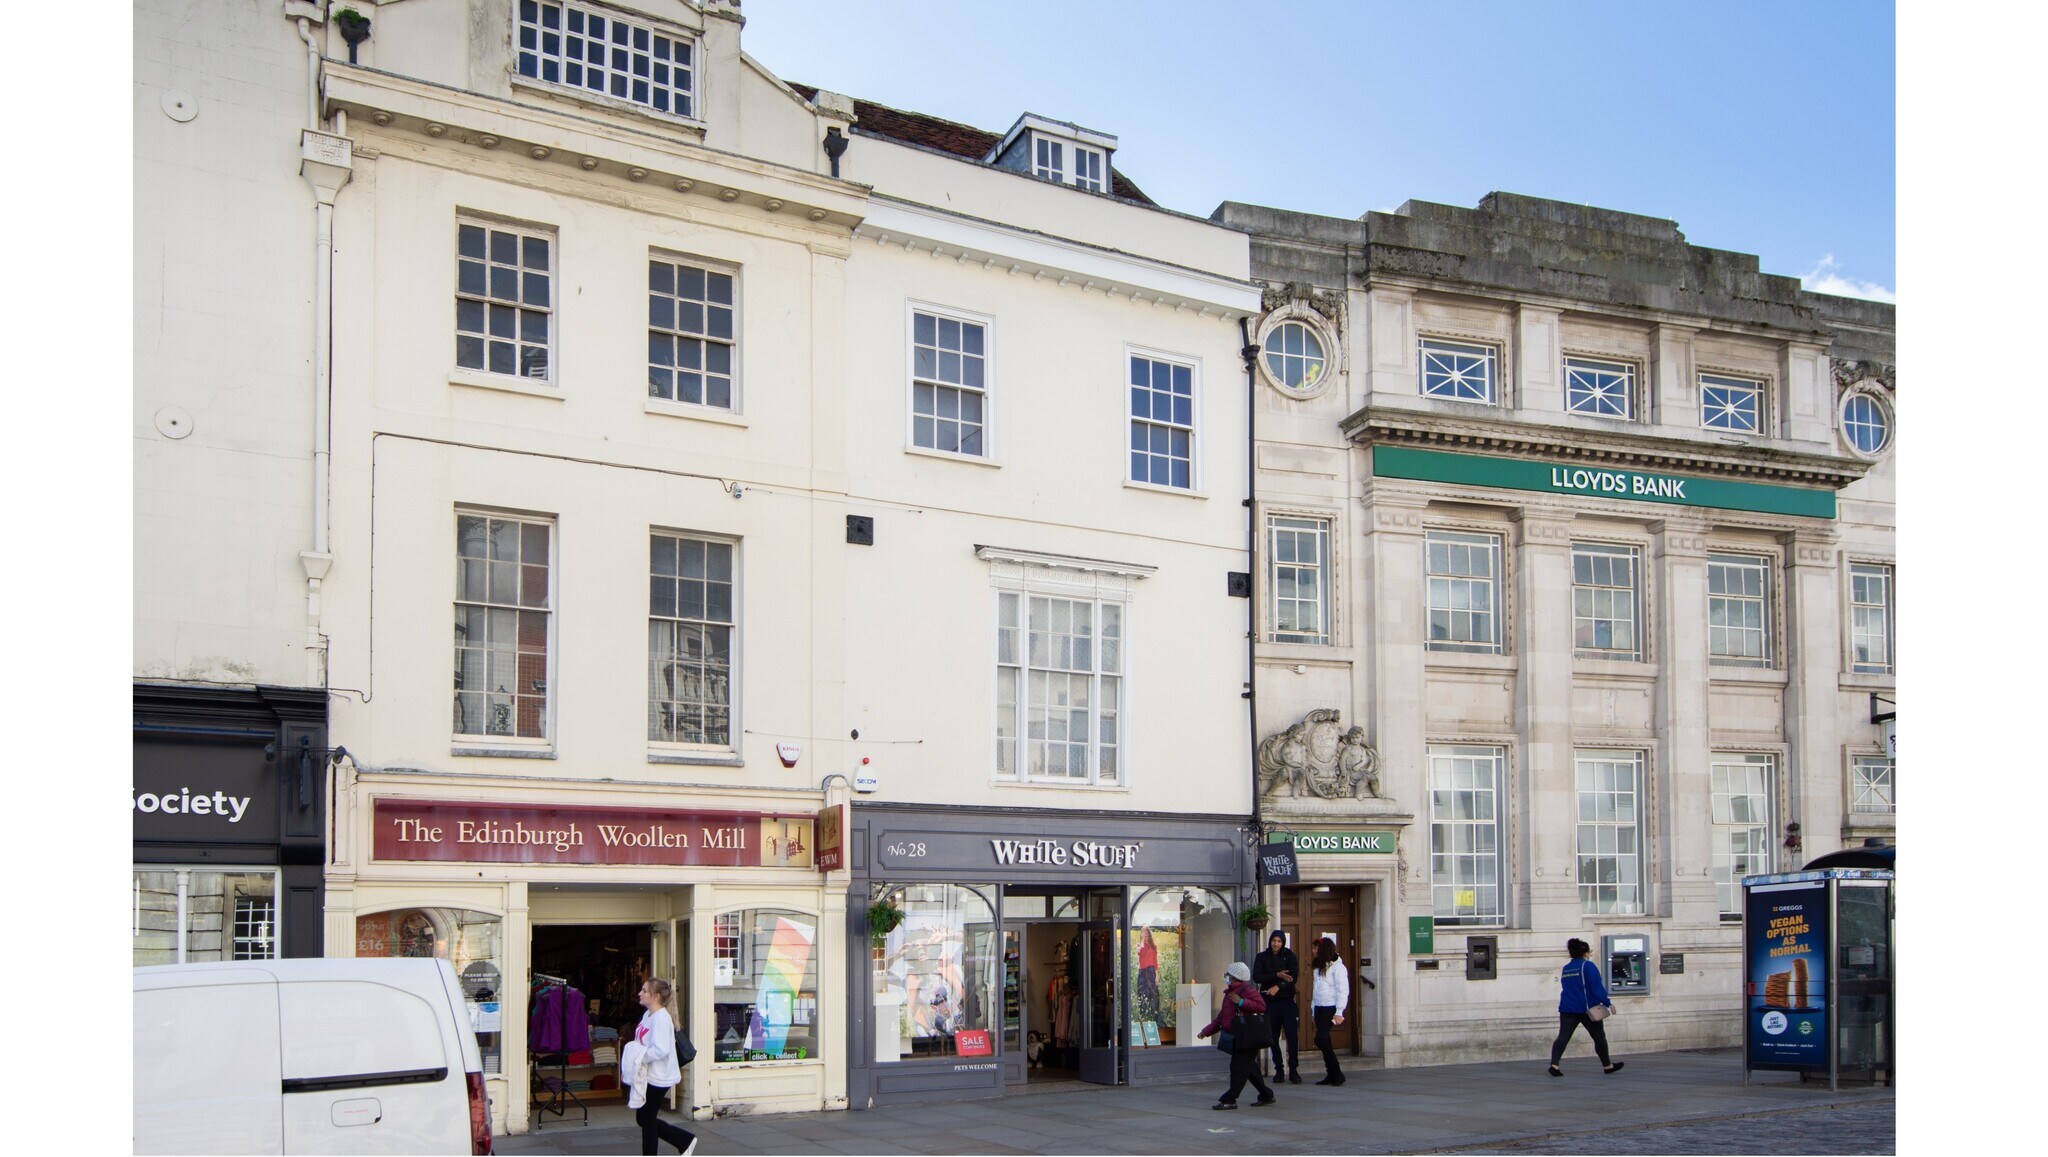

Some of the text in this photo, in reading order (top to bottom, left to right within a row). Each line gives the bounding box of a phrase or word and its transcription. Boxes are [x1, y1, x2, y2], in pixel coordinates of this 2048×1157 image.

[1552, 467, 1686, 499] LLOYDS BANK
[394, 818, 747, 853] The Edinburgh Woollen Mill
[887, 842, 927, 857] No 28
[1342, 836, 1380, 850] BANK
[820, 853, 838, 867] EWM
[1778, 904, 1803, 912] GREGGS
[1769, 914, 1804, 929] VEGAN
[1766, 923, 1810, 939] OPTIONS
[358, 940, 384, 951] £16
[1782, 936, 1796, 946] AS
[1769, 943, 1812, 958] NORMAL
[961, 1036, 984, 1046] SALE
[751, 1053, 768, 1061] click
[775, 1052, 798, 1060] collect
